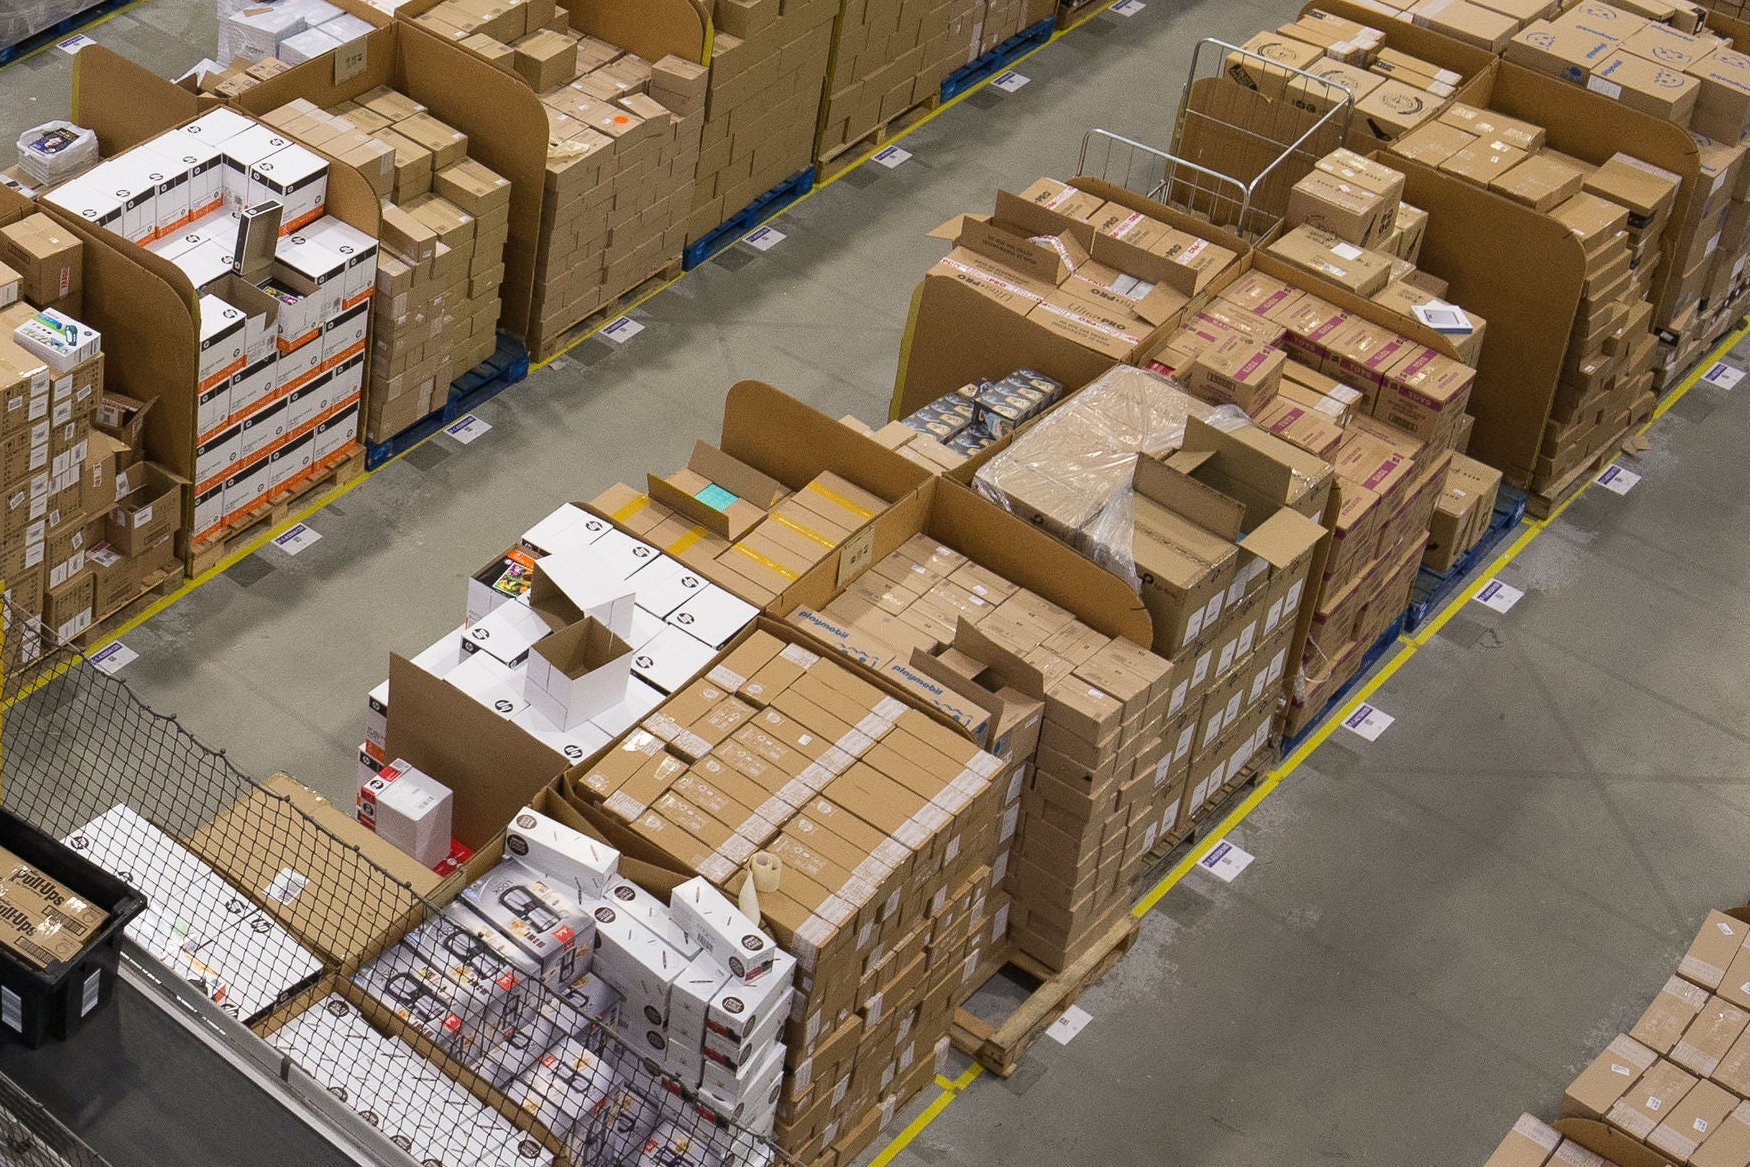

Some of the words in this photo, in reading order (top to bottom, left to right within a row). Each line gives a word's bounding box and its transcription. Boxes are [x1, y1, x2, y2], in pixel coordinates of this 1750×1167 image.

[798, 610, 849, 640] playmobil
[891, 664, 944, 696] playmobil
[9, 870, 66, 906] Pull-Ups
